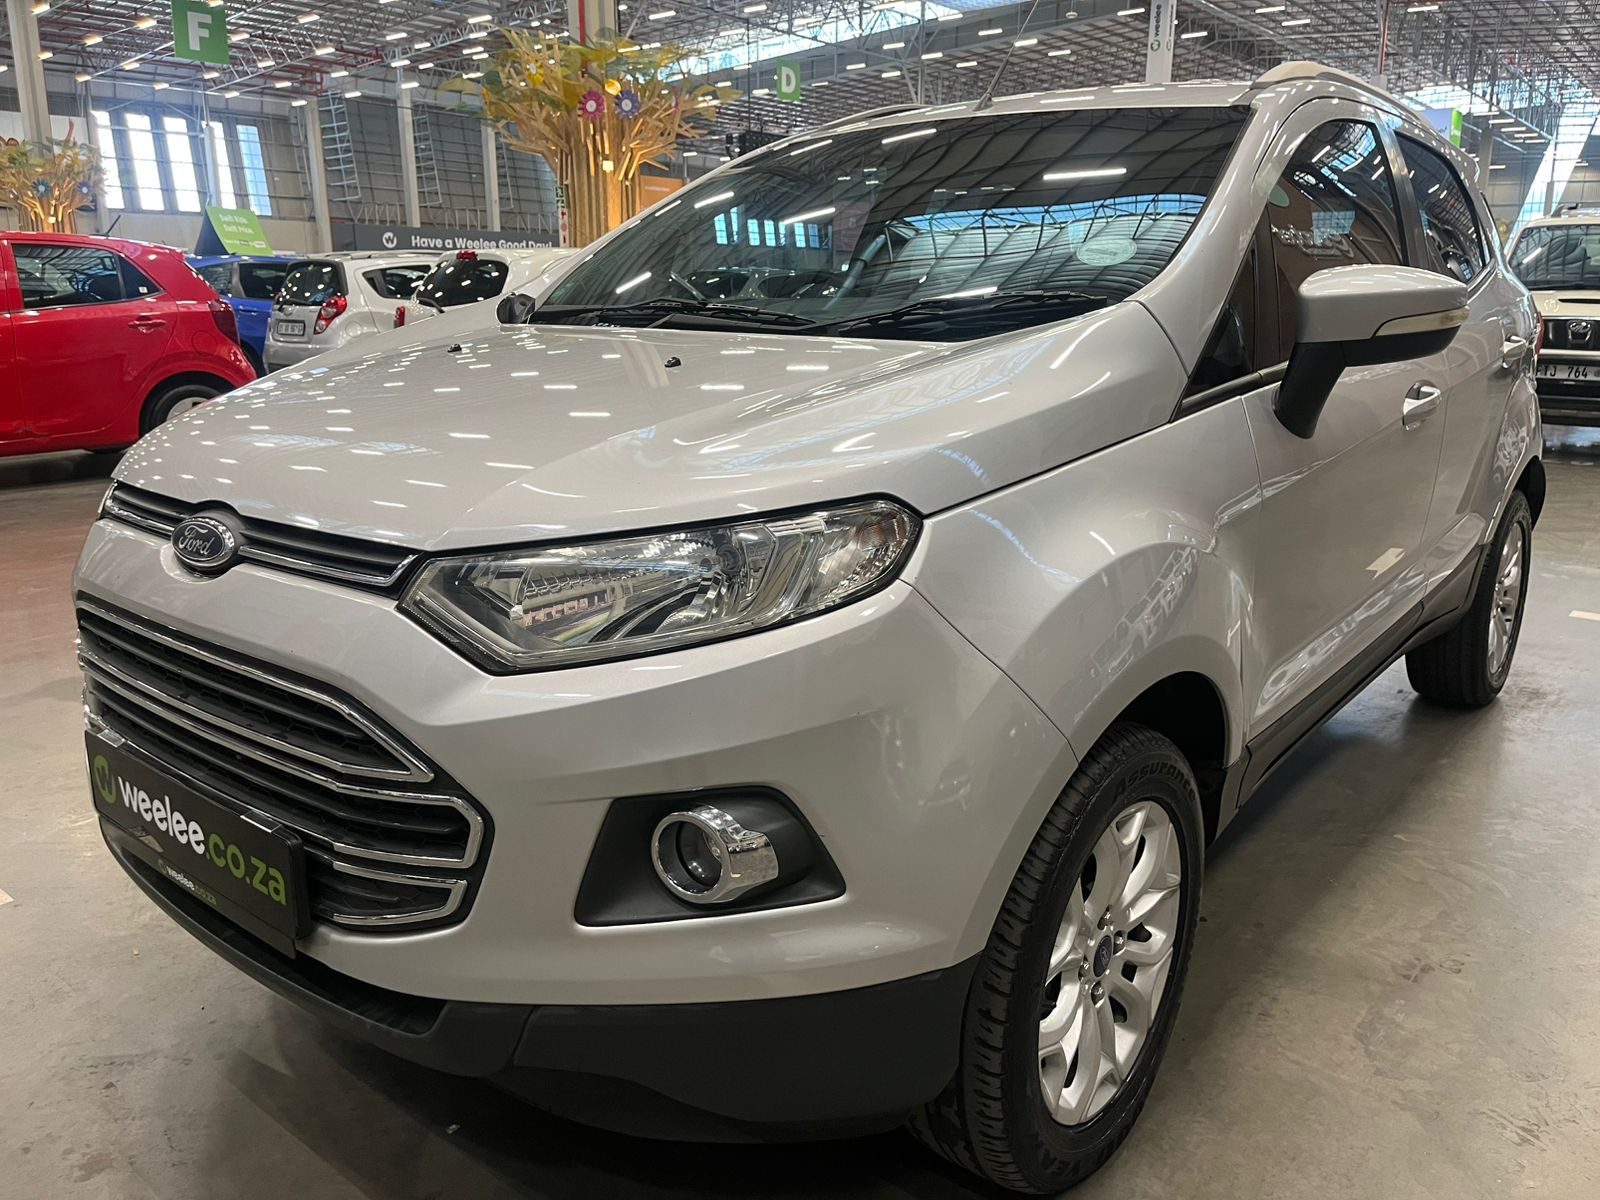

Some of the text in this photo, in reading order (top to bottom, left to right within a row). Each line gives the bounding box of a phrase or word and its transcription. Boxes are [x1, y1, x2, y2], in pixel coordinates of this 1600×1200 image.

[187, 11, 212, 51] F
[781, 66, 797, 94] D
[411, 235, 443, 248] Have
[445, 238, 453, 249] a
[454, 237, 496, 250] Weelee
[498, 239, 527, 249] Good
[1567, 366, 1588, 379] 764
[178, 525, 215, 555] Ford
[1112, 761, 1196, 805] Assurance
[118, 776, 288, 906] weelee.co.za
